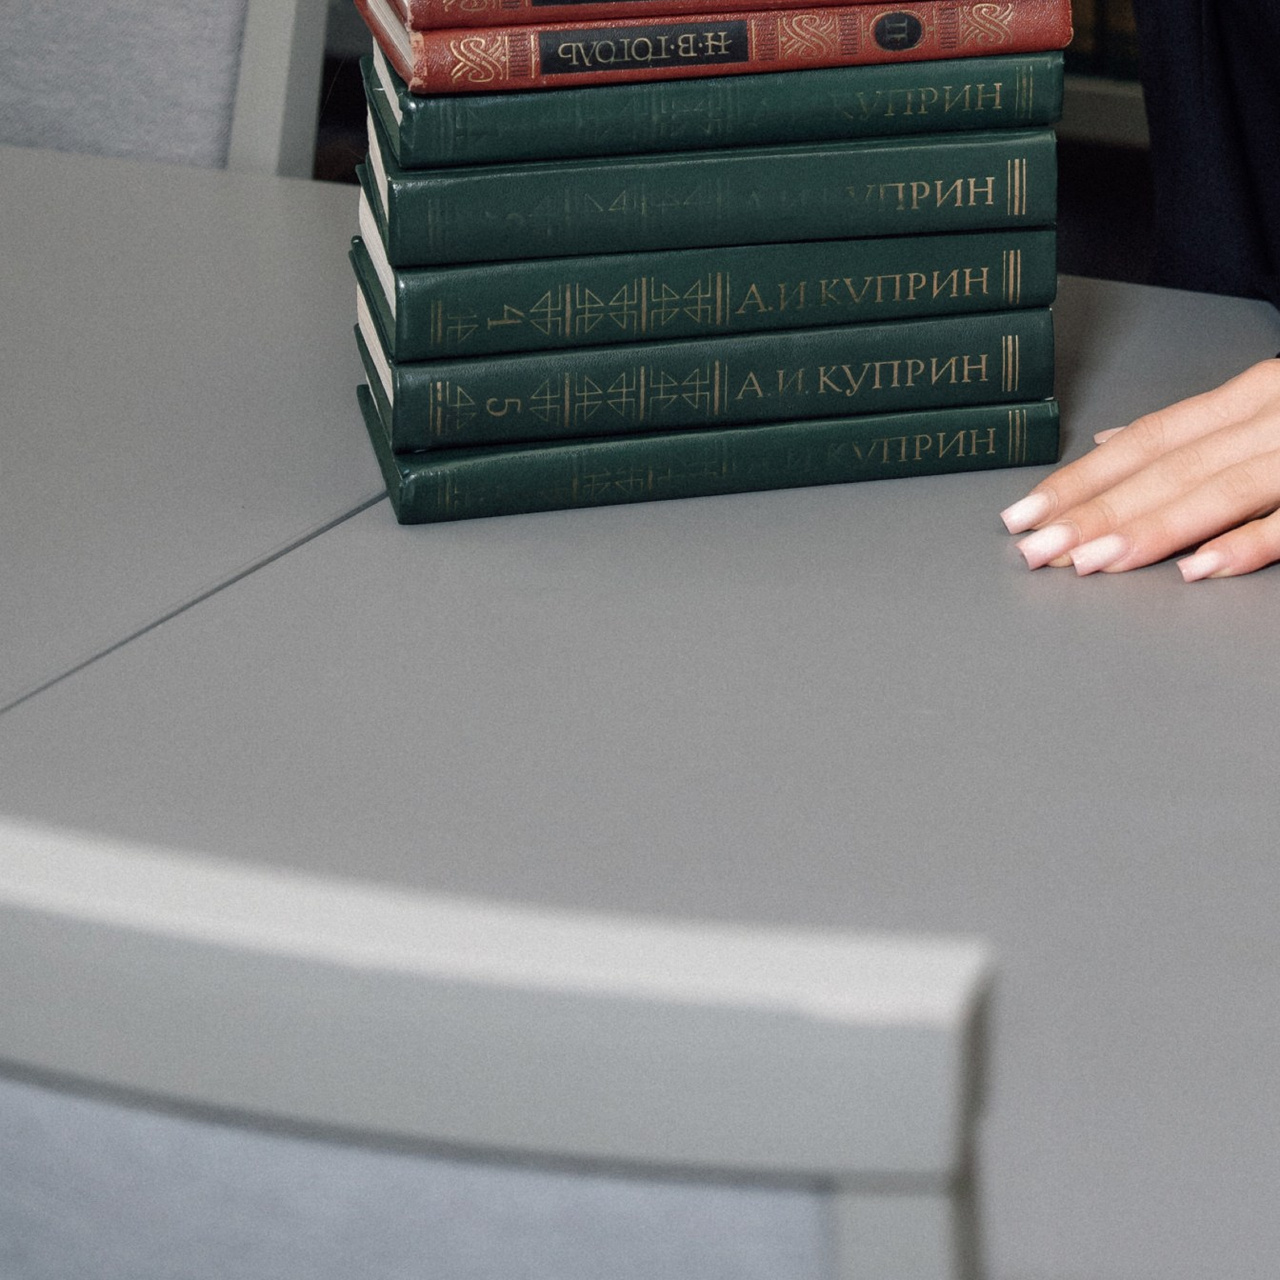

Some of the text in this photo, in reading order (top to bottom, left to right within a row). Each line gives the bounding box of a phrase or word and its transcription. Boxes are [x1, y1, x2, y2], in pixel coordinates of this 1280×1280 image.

[845, 176, 995, 211] ПРИН
[819, 266, 990, 308] КУПРИН
[487, 303, 529, 330] 4
[817, 353, 989, 397] КУПРИН
[486, 397, 522, 417] 5
